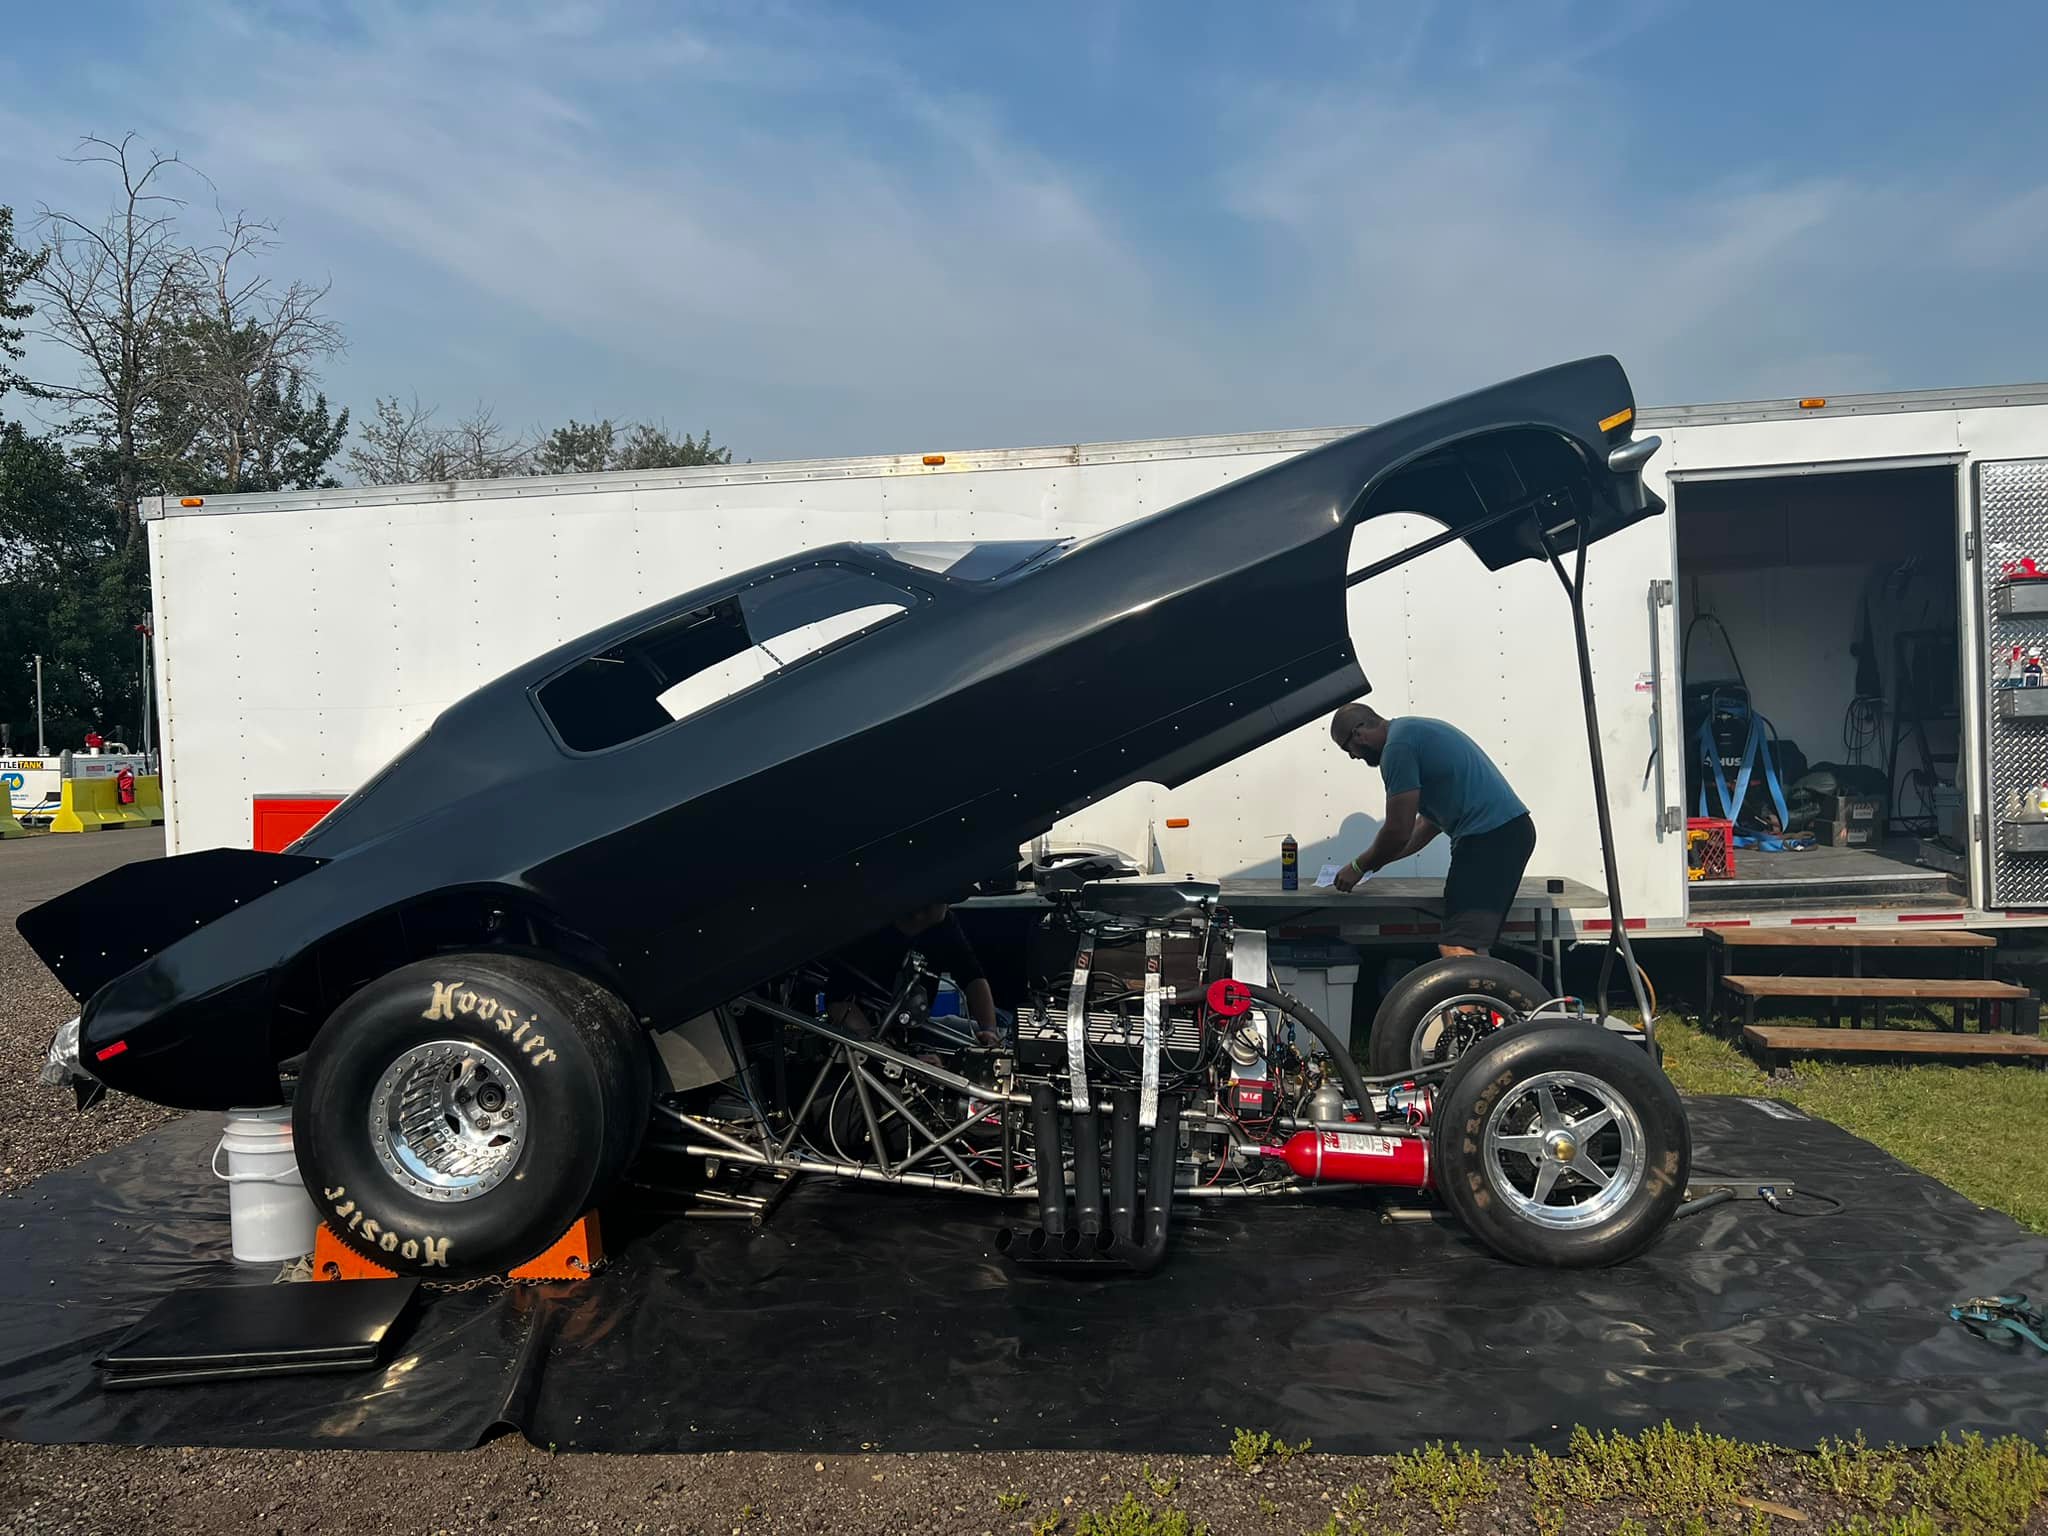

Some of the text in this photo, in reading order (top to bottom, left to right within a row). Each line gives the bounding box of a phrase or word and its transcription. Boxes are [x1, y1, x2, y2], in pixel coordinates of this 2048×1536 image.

[18, 761, 43, 769] TANK
[422, 980, 558, 1066] Hoosier
[324, 1186, 451, 1268] Hoosier
